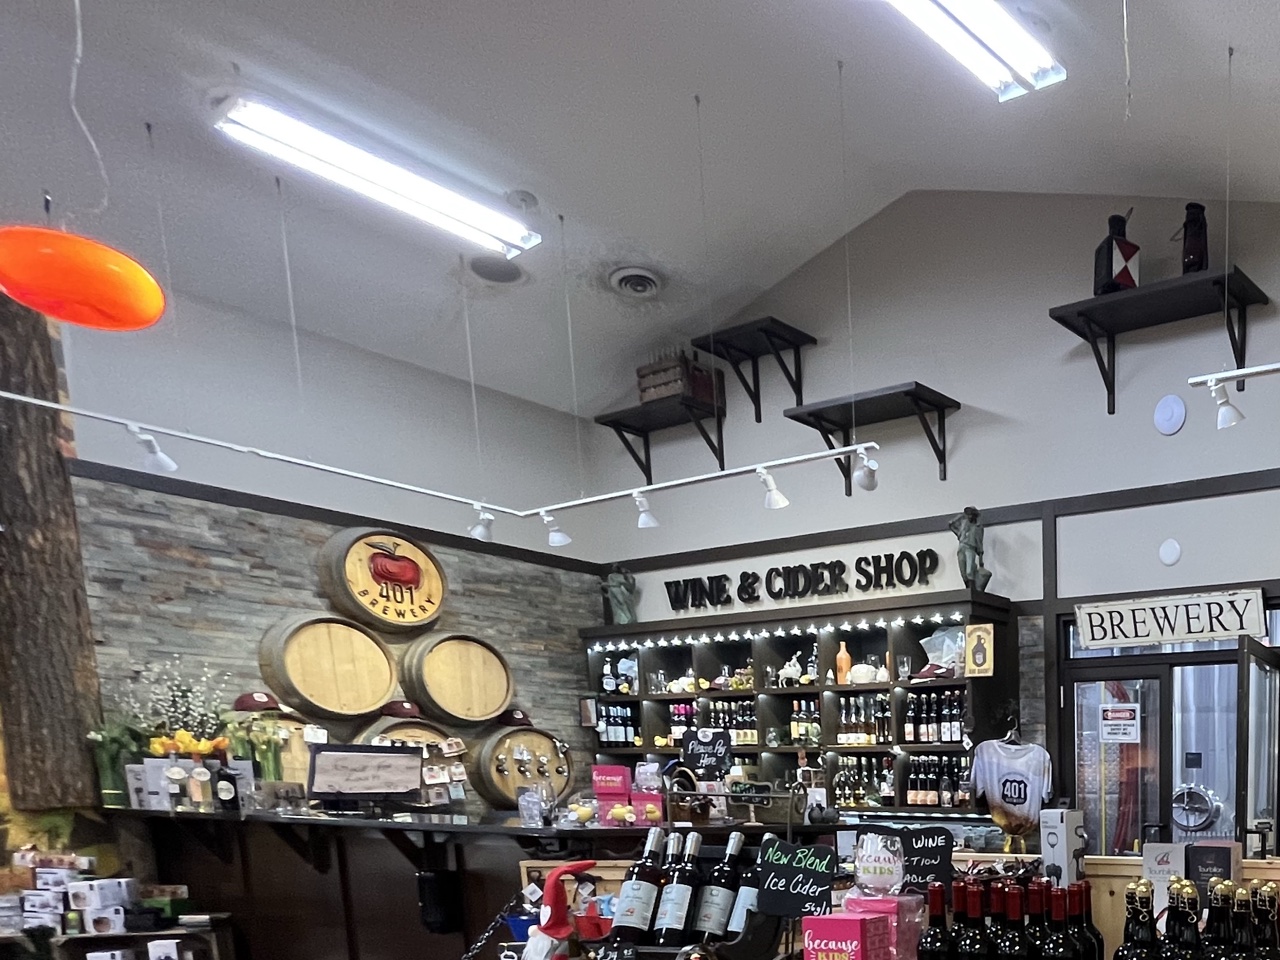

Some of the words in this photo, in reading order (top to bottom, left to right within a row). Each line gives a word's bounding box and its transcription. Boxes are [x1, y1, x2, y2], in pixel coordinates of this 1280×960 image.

[664, 574, 731, 611] WINE
[737, 571, 761, 603] &
[765, 560, 849, 601] CIDER
[855, 549, 939, 592] SHOP
[358, 589, 436, 619] BREWERY
[379, 581, 415, 606] 401
[1085, 598, 1252, 642] BREWERY
[688, 740, 714, 754] Please
[715, 740, 727, 757] Pay
[697, 756, 717, 766] Here
[1003, 781, 1025, 799] 401
[912, 835, 946, 849] WINE
[764, 842, 788, 865] New
[791, 849, 831, 873] Blend
[764, 875, 786, 891] Ice
[789, 874, 830, 897] Cider
[804, 929, 860, 951] because
